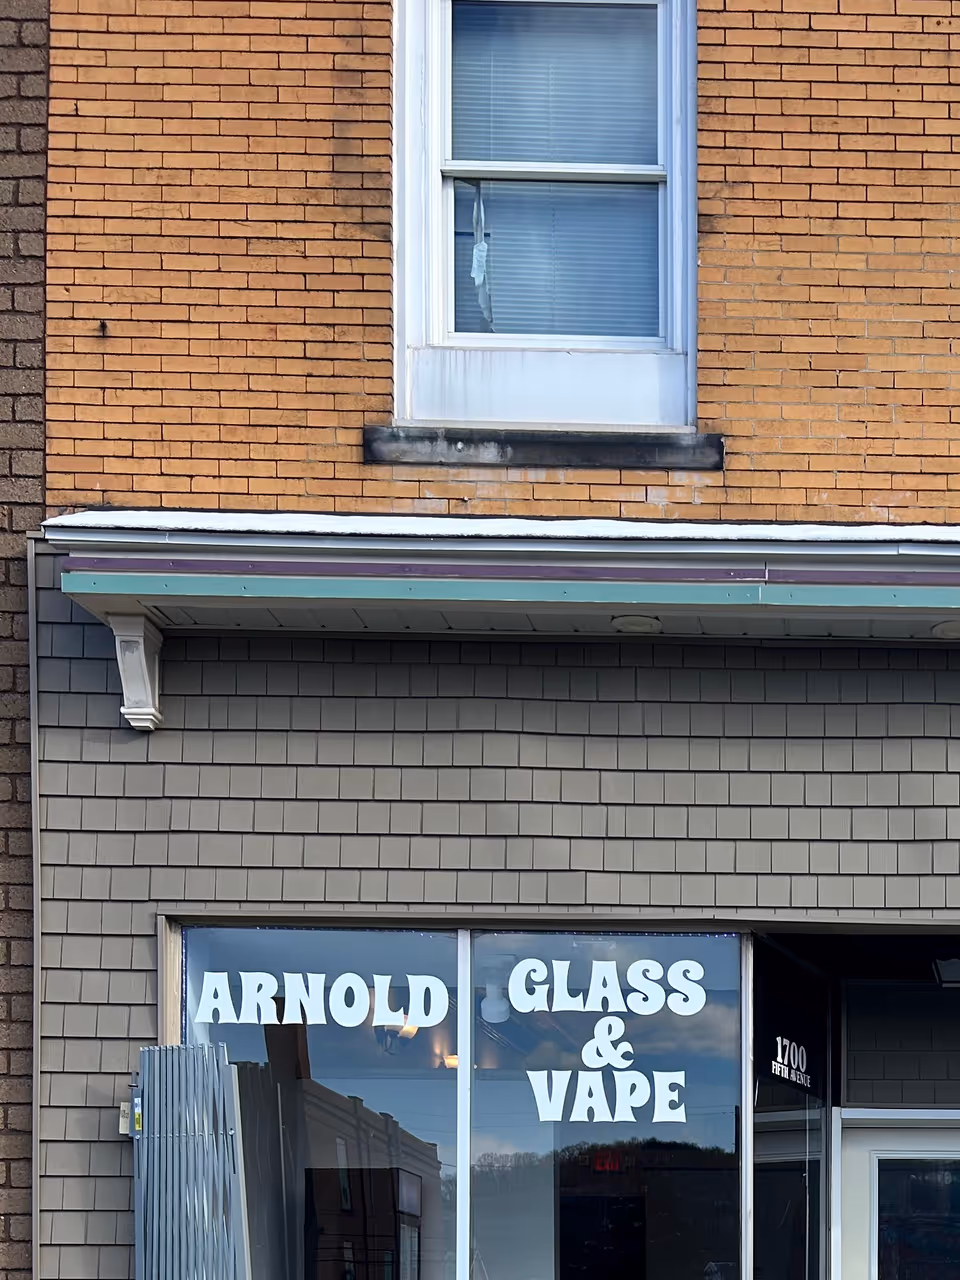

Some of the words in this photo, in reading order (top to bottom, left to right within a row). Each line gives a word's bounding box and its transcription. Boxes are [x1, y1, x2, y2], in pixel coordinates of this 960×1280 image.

[194, 971, 449, 1029] ARNOLD
[508, 958, 707, 1016] GLASS
[582, 1016, 634, 1069] &
[776, 1036, 807, 1073] 1700
[771, 1060, 790, 1079] FIFTH
[526, 1070, 687, 1124] VAPE
